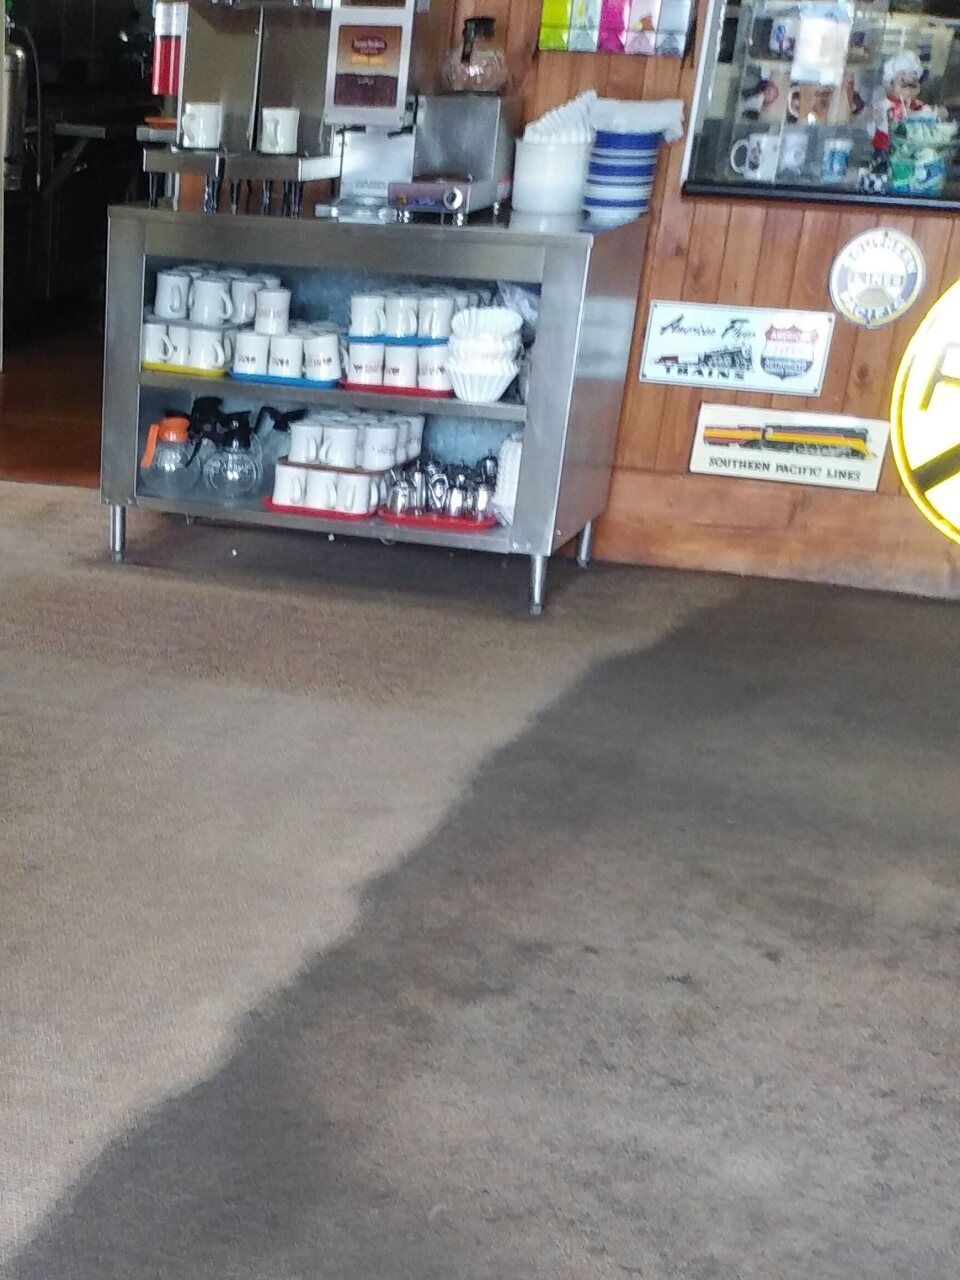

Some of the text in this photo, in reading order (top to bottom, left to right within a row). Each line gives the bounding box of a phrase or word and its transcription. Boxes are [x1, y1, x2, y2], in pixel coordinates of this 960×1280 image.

[708, 455, 861, 482] SOUTHERN PACIFIC LINES
